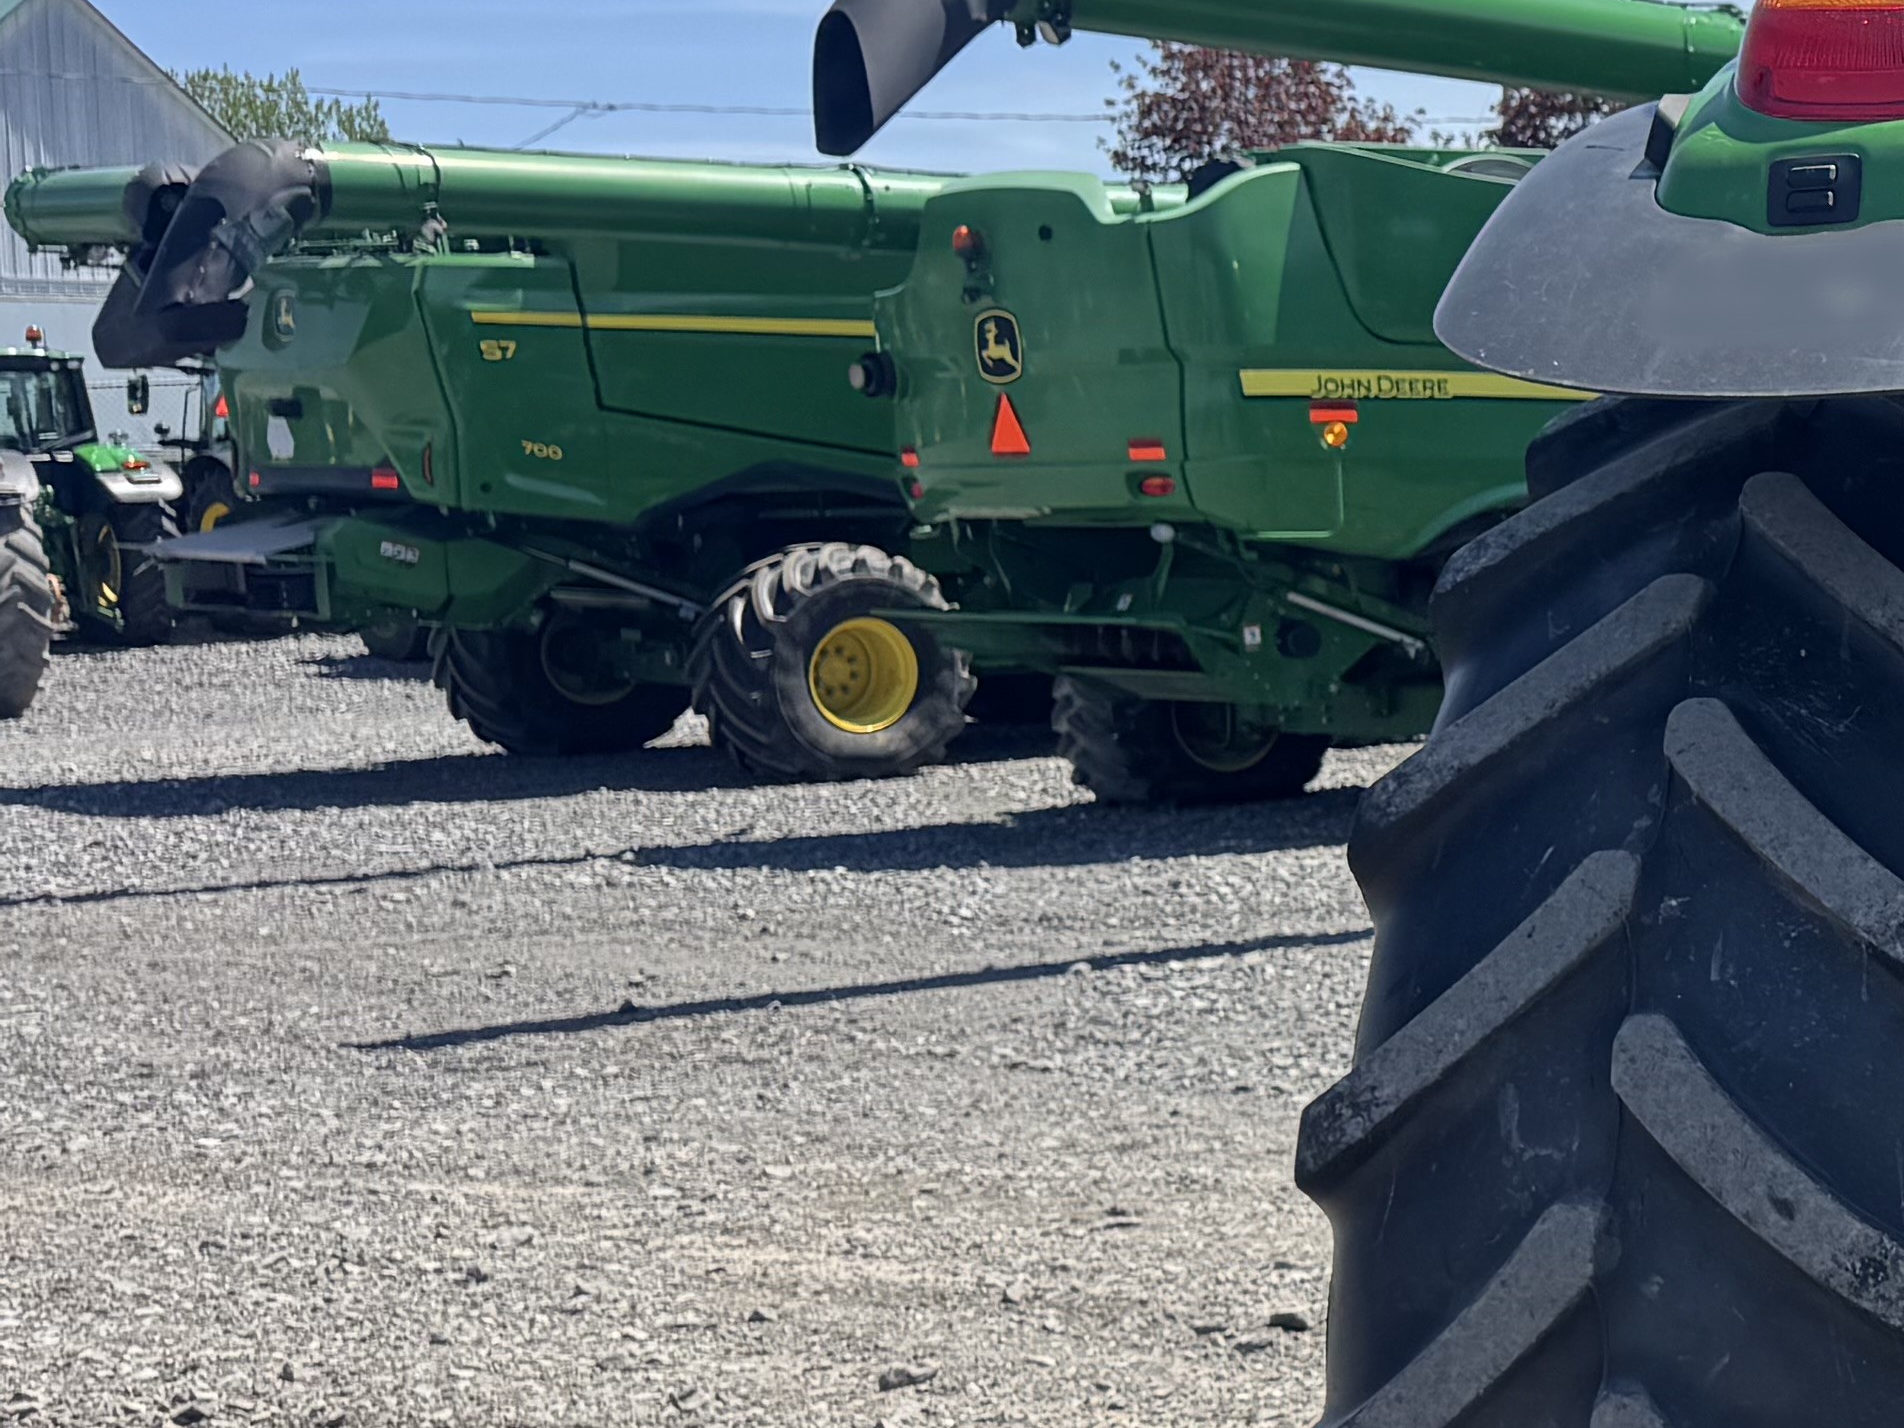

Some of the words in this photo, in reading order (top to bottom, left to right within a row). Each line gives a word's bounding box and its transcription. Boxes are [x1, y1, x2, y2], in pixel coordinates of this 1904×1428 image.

[1312, 374, 1372, 396] JOHN
[1377, 374, 1449, 396] DEERE
[521, 439, 563, 461] 700
